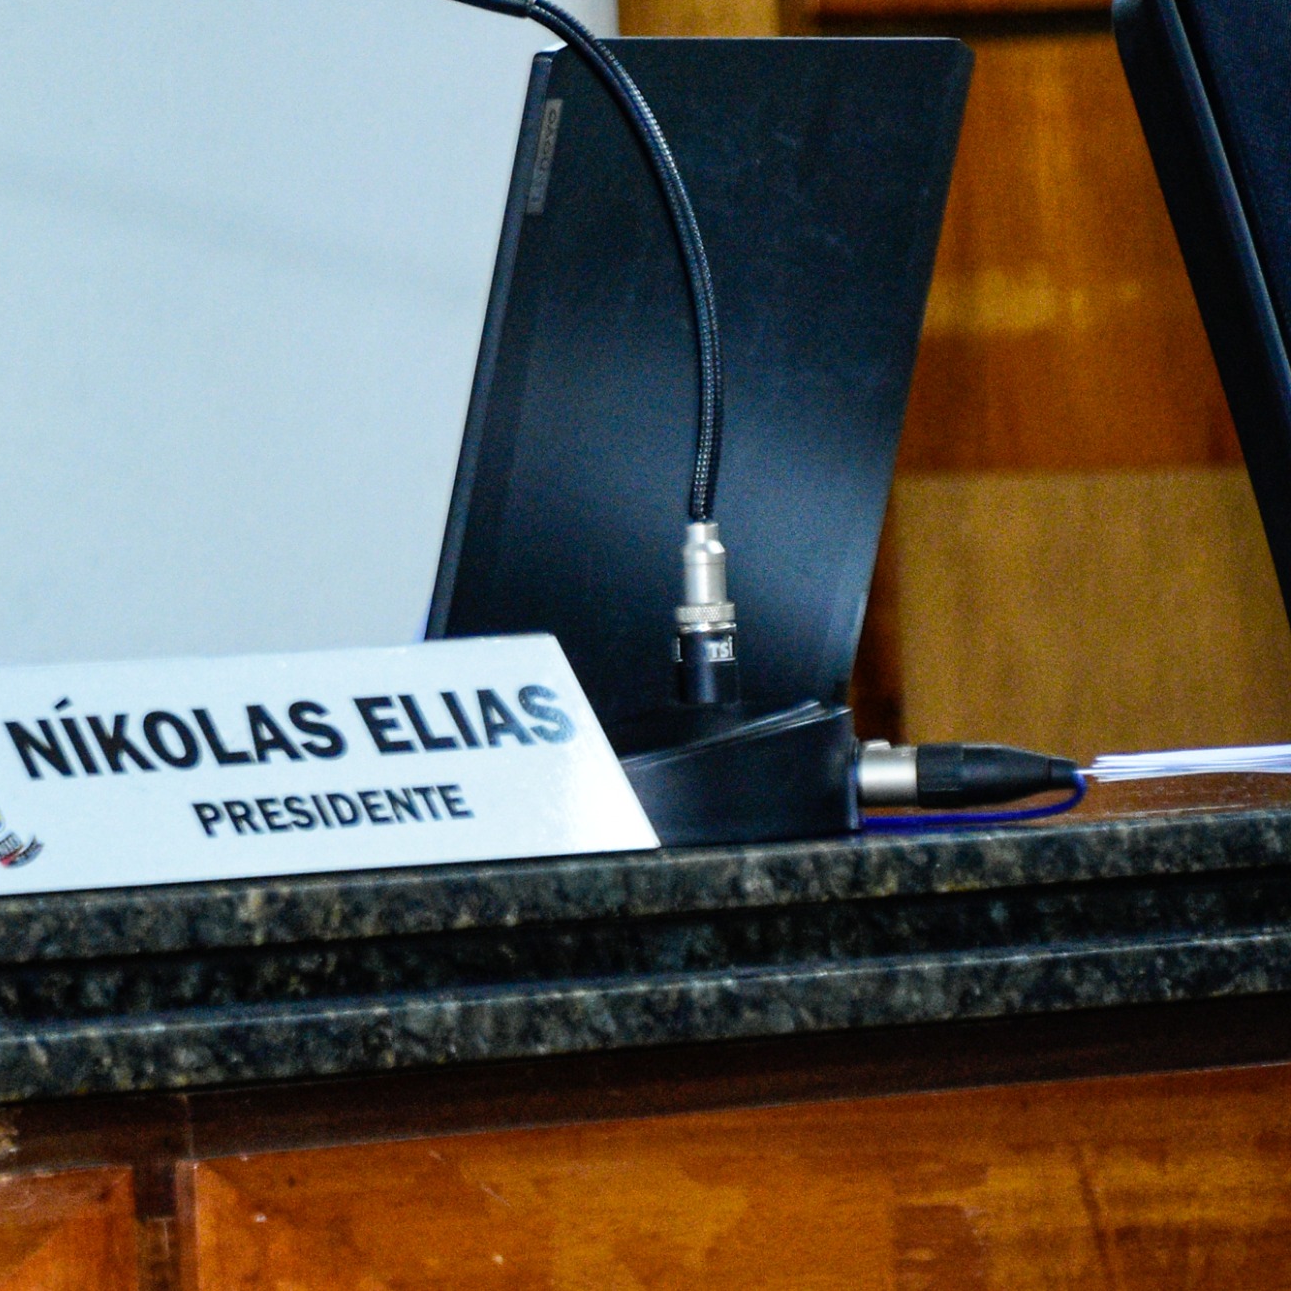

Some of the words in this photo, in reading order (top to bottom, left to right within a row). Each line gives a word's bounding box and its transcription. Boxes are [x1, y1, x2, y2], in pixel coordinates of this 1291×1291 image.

[4, 697, 348, 779] NÍKOLAS
[352, 685, 576, 754] ELIAS
[192, 784, 474, 837] PRESIDENTE
